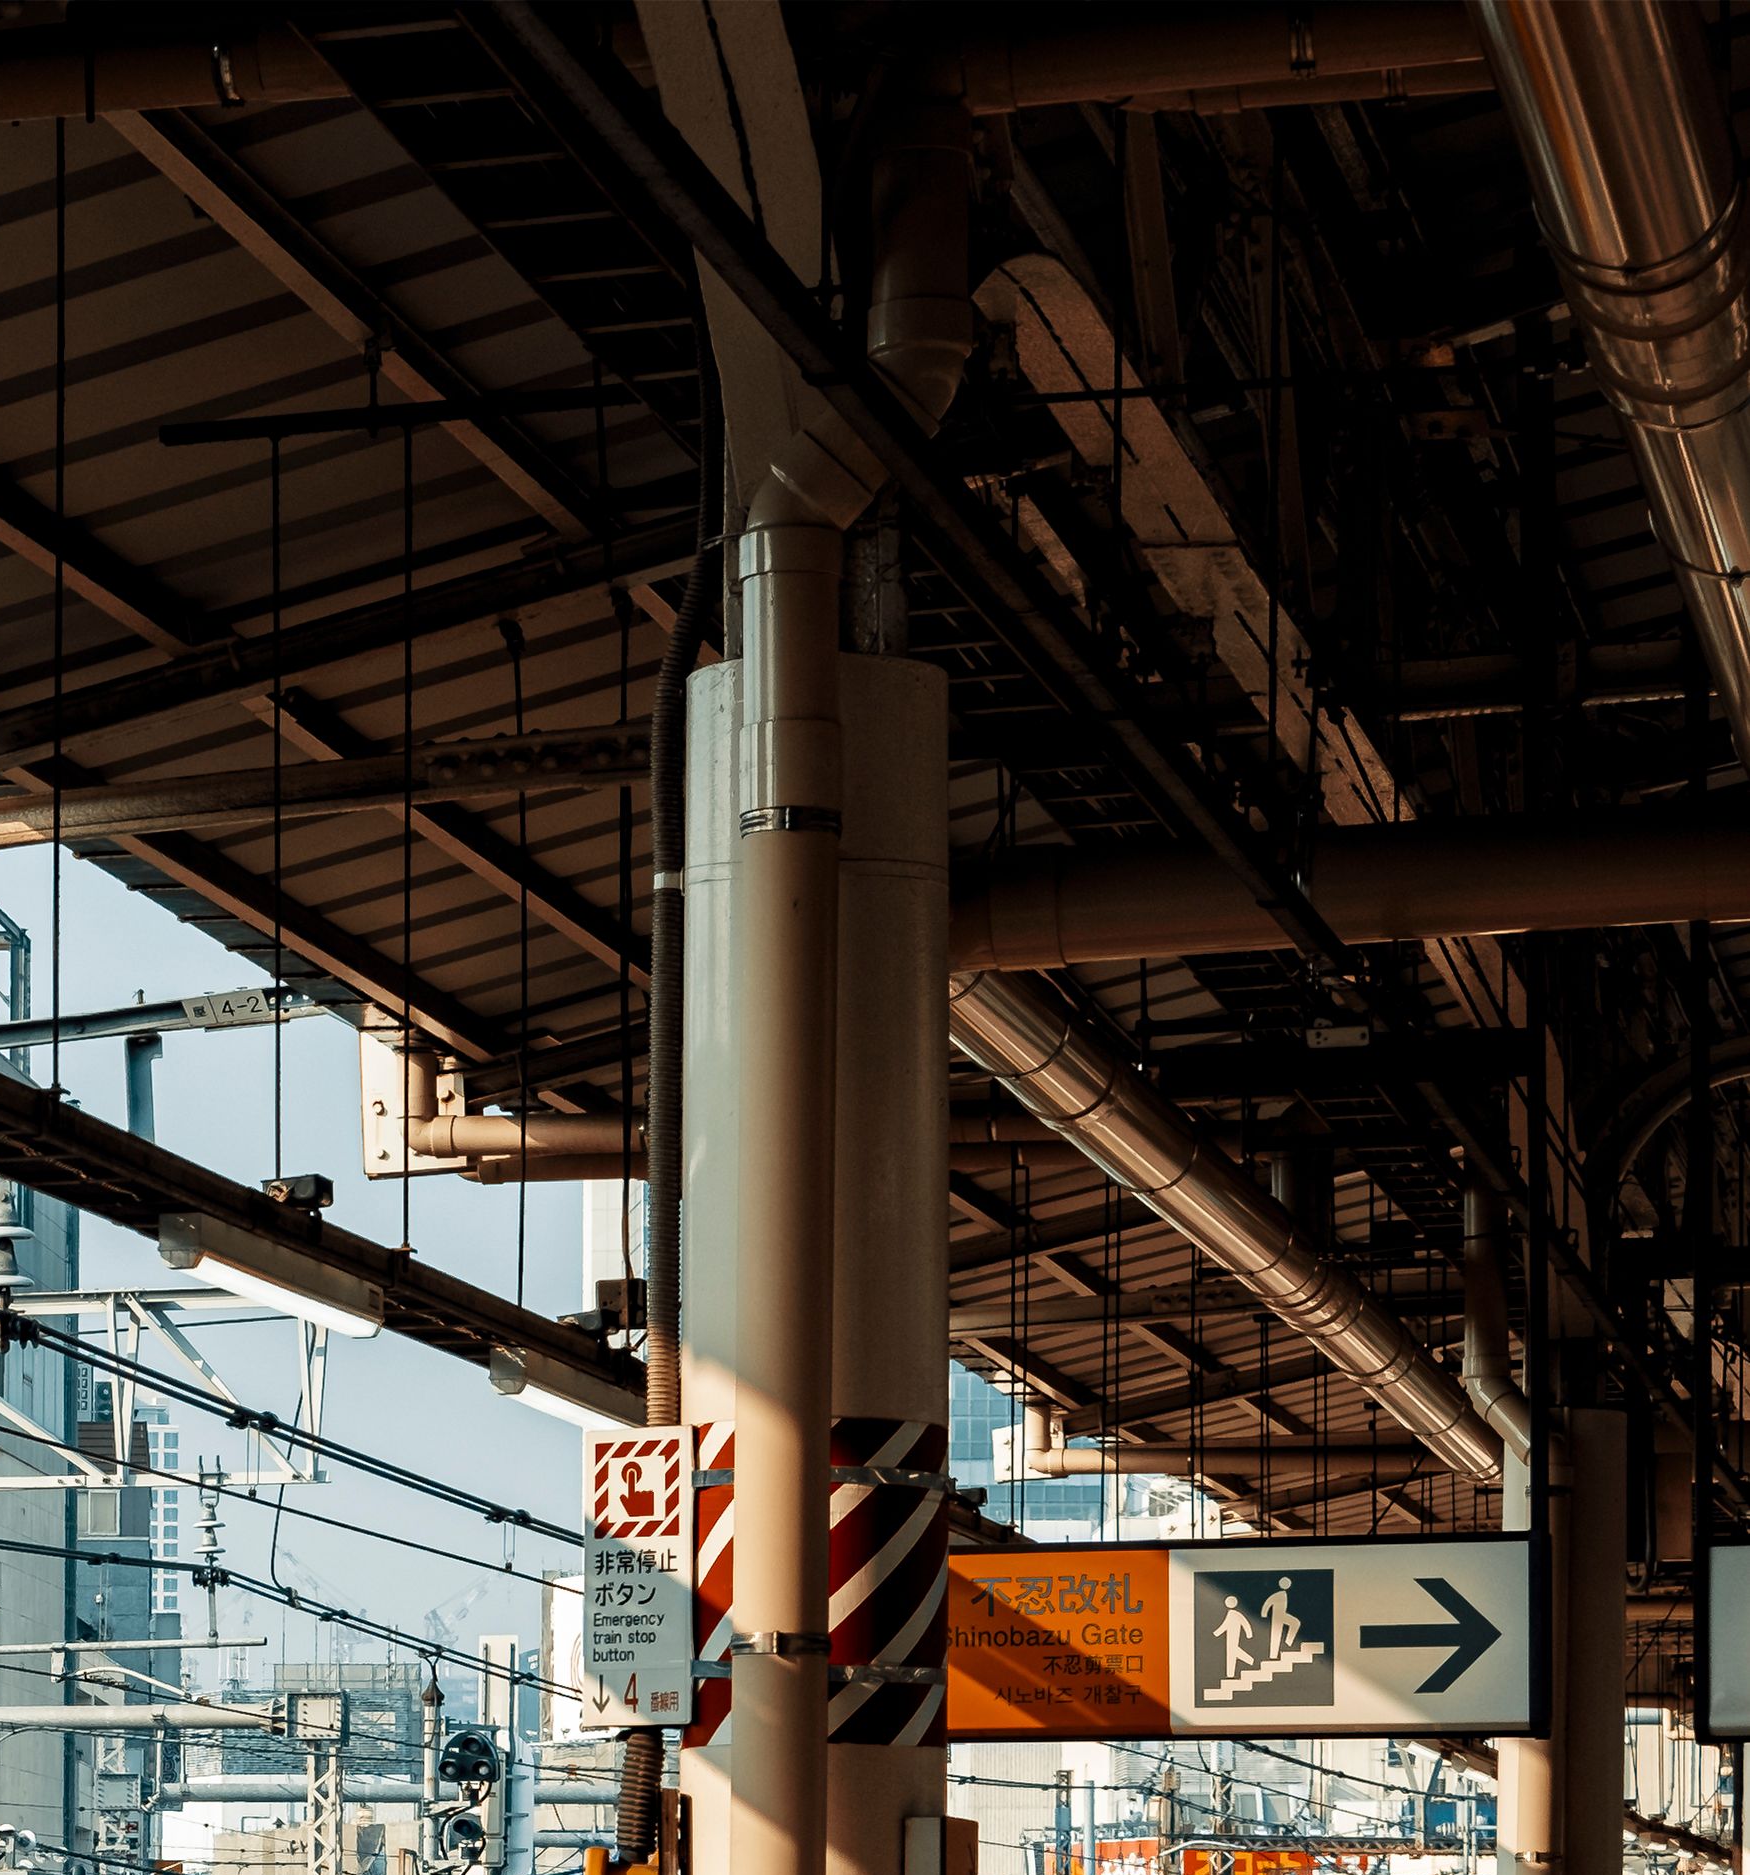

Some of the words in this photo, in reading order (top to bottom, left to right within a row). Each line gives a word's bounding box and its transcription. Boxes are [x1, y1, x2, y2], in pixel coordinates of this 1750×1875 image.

[594, 1548, 678, 1576] 非常停止
[595, 1582, 657, 1607] ボタン
[970, 1572, 1144, 1617] 不忍改札
[593, 1612, 666, 1628] Emergency
[593, 1630, 622, 1645] train
[628, 1630, 657, 1644] stop
[1081, 1623, 1144, 1645] Gate
[592, 1648, 635, 1663] button
[1042, 1655, 1144, 1676] 不忍剪票口
[624, 1671, 639, 1714] 4
[995, 1685, 1074, 1707] 시노바즈
[1084, 1685, 1144, 1706] 개찰구
